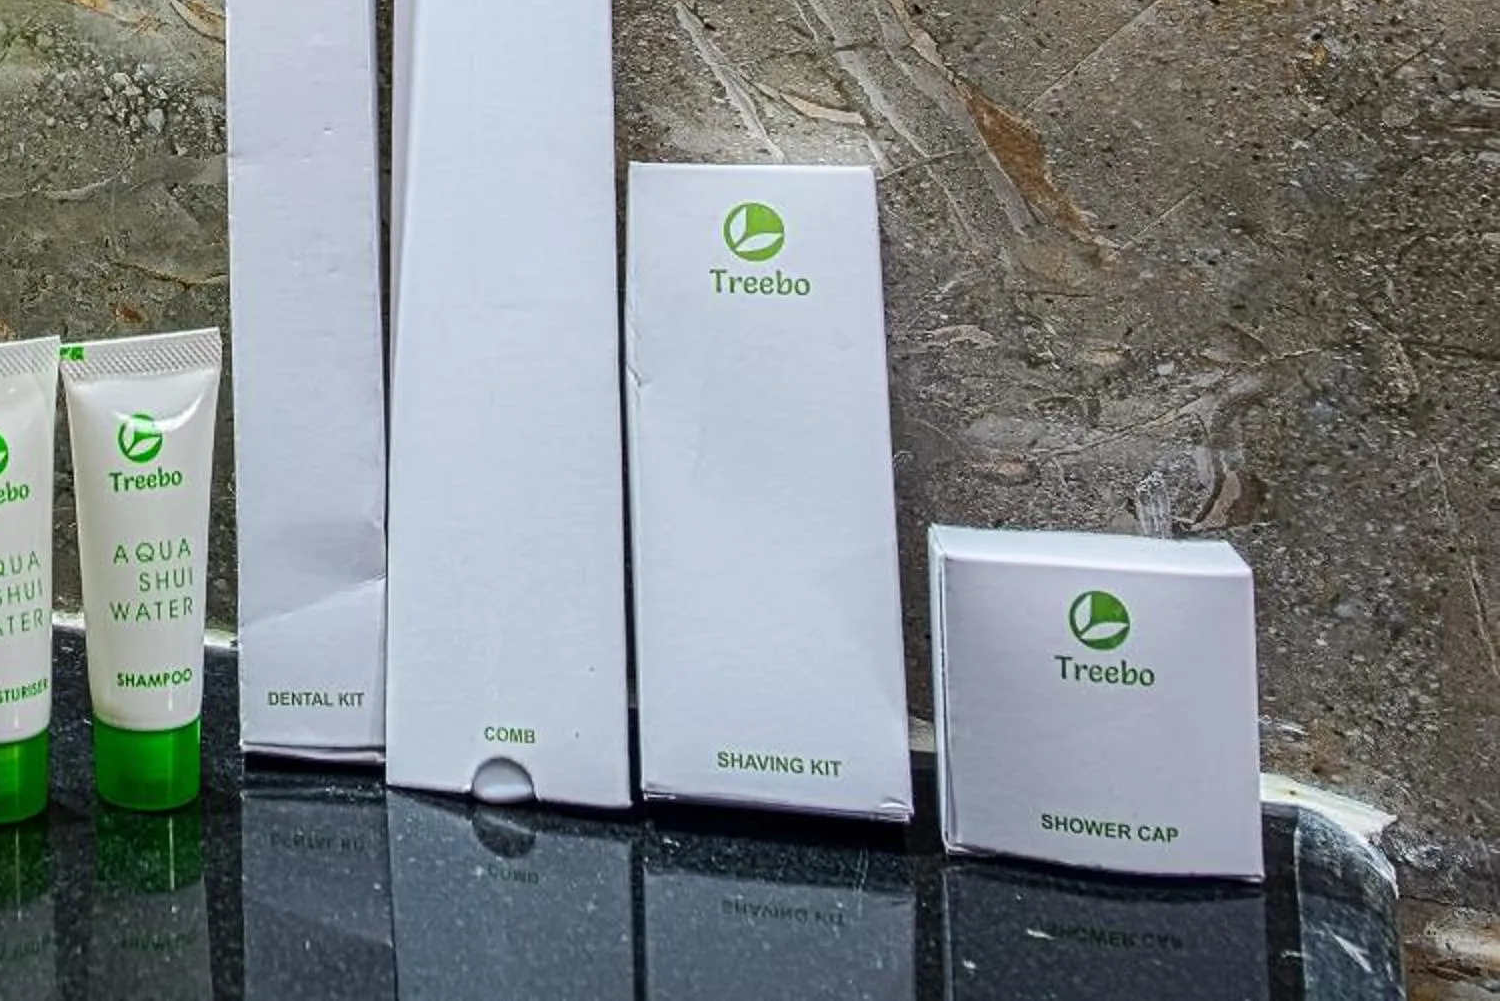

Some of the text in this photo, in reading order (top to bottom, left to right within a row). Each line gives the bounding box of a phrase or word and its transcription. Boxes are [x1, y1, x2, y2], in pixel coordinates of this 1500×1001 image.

[708, 268, 811, 296] Treebo
[108, 467, 184, 493] Treebo
[113, 537, 192, 565] AQUA
[138, 566, 194, 593] SHUI
[109, 596, 194, 623] WATER
[116, 667, 193, 689] SHAMPOO
[1054, 654, 1156, 687] Treebo
[267, 691, 365, 707] DENTAL KIT
[483, 725, 537, 744] COMB
[716, 750, 843, 777] SHAVING KIT
[1041, 813, 1180, 843] SHOWER CAP
